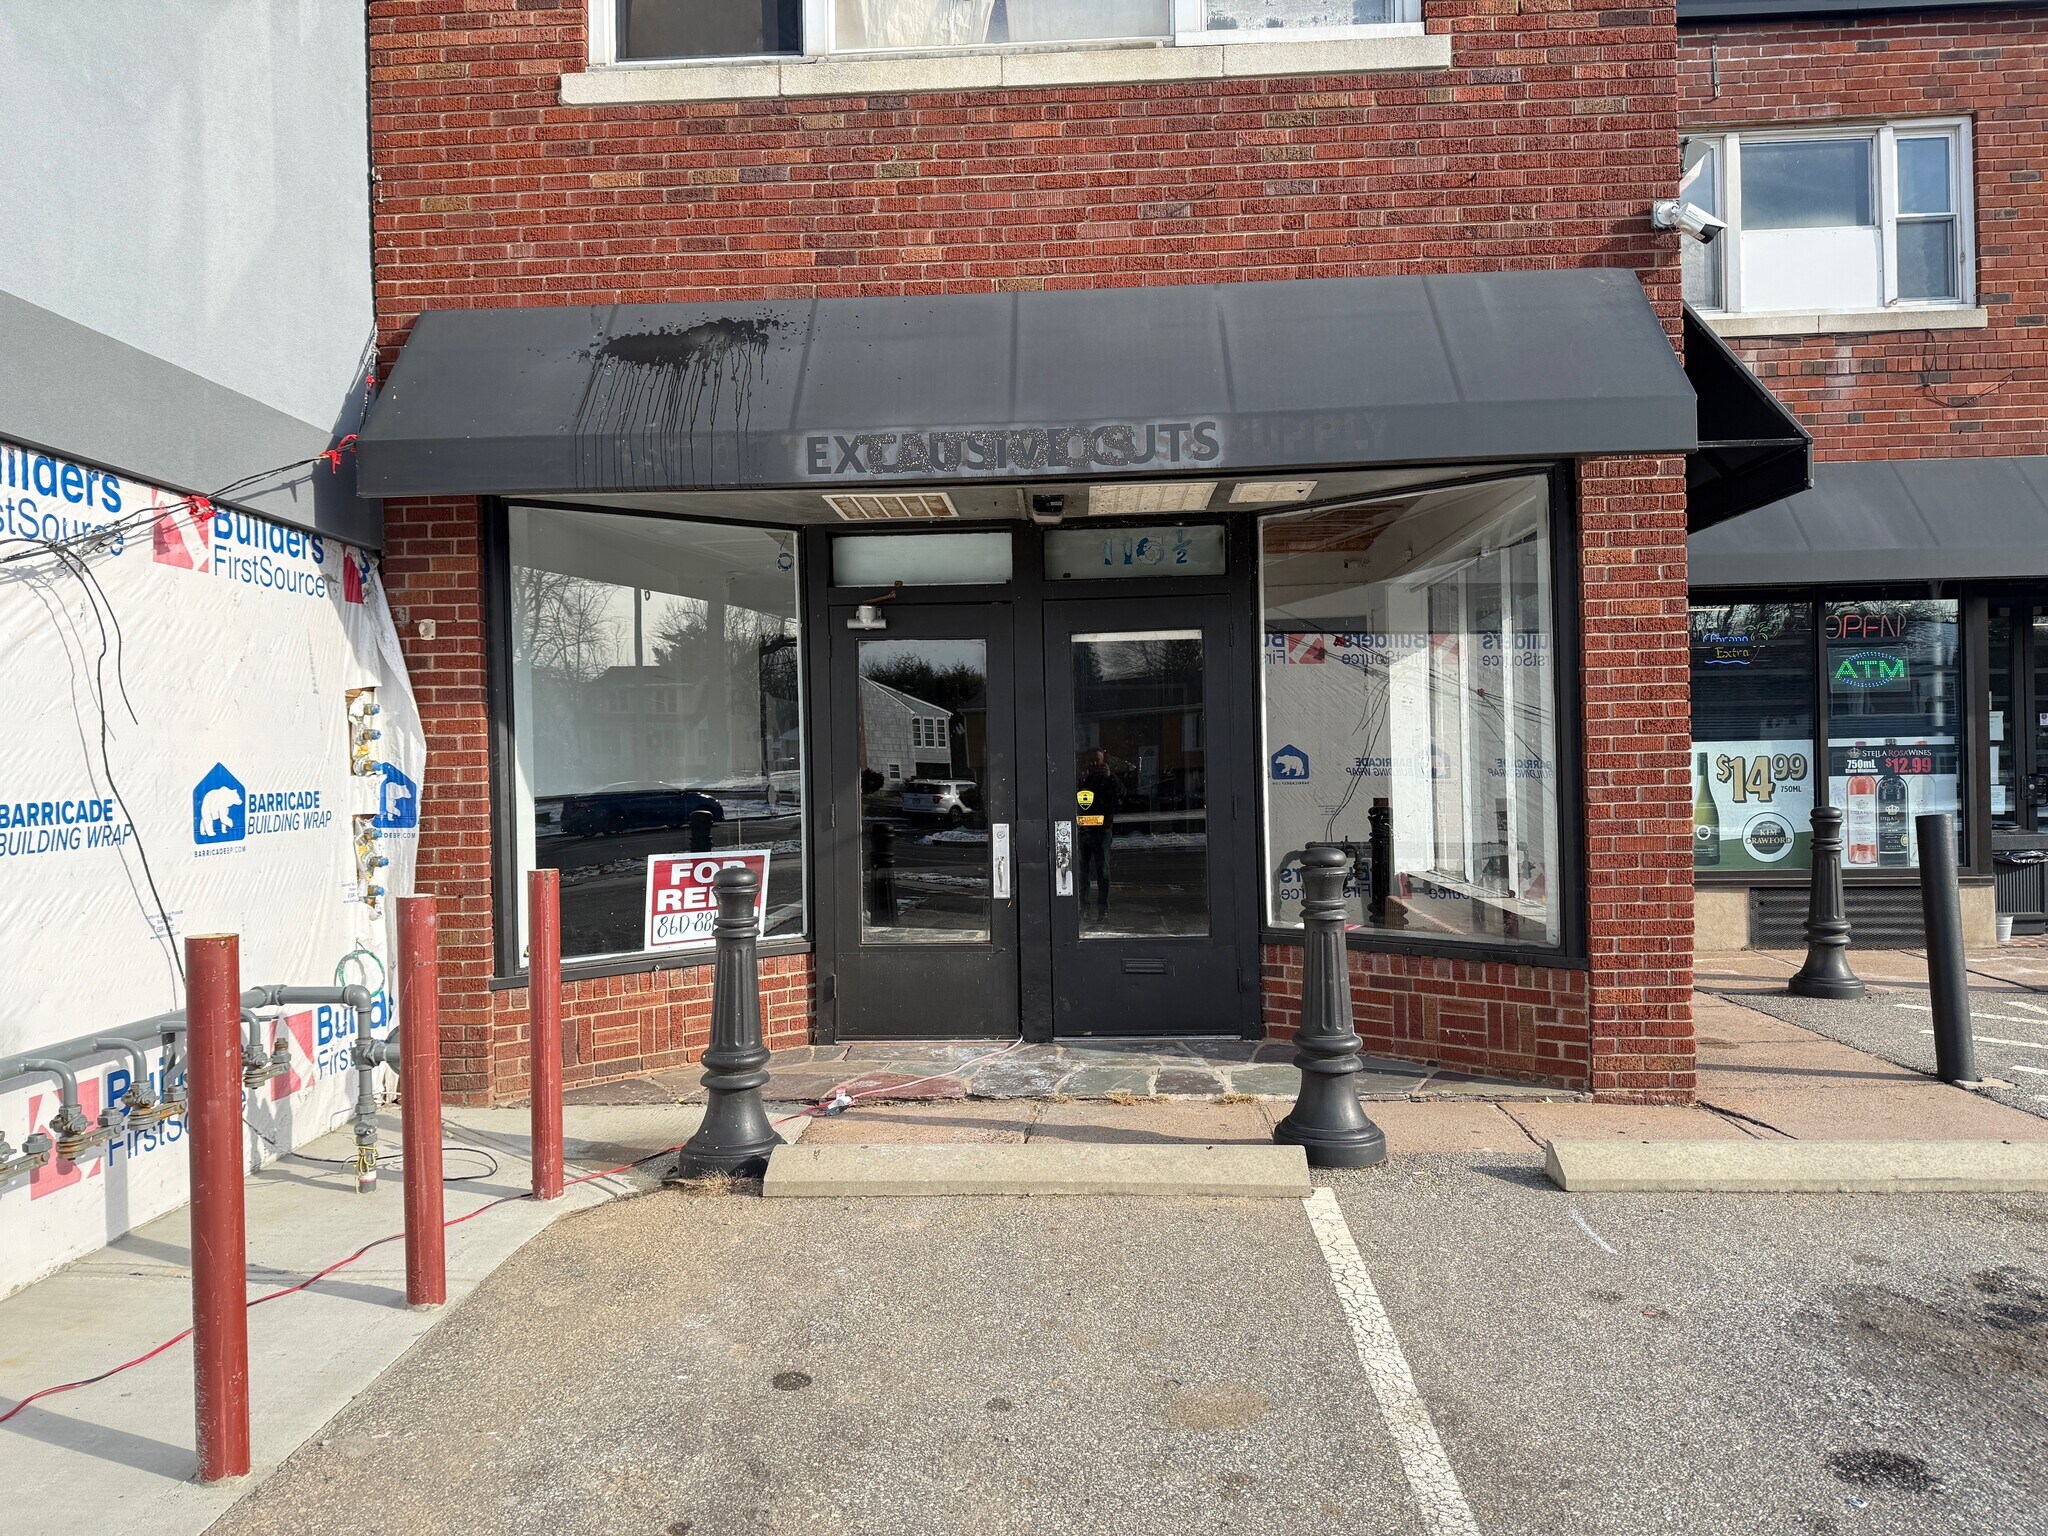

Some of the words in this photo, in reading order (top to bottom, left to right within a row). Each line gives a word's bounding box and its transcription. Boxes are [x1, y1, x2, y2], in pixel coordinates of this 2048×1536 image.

[214, 544, 326, 598] FirstSource
[1714, 646, 1750, 659] Extra
[1834, 659, 1905, 679] ATM
[1862, 749, 1887, 757] STELLA
[1846, 759, 1876, 769] 750mL
[1885, 757, 1932, 774] $12.99
[1780, 785, 1802, 793] 750ML
[249, 790, 321, 813] BARRICADE
[0, 799, 114, 829] BARRICADE
[247, 812, 300, 835] BUILDING
[302, 810, 332, 829] WRAP
[0, 827, 82, 857] BUILDING
[87, 823, 133, 849] WRAP
[1745, 836, 1793, 845] CRAWFORD
